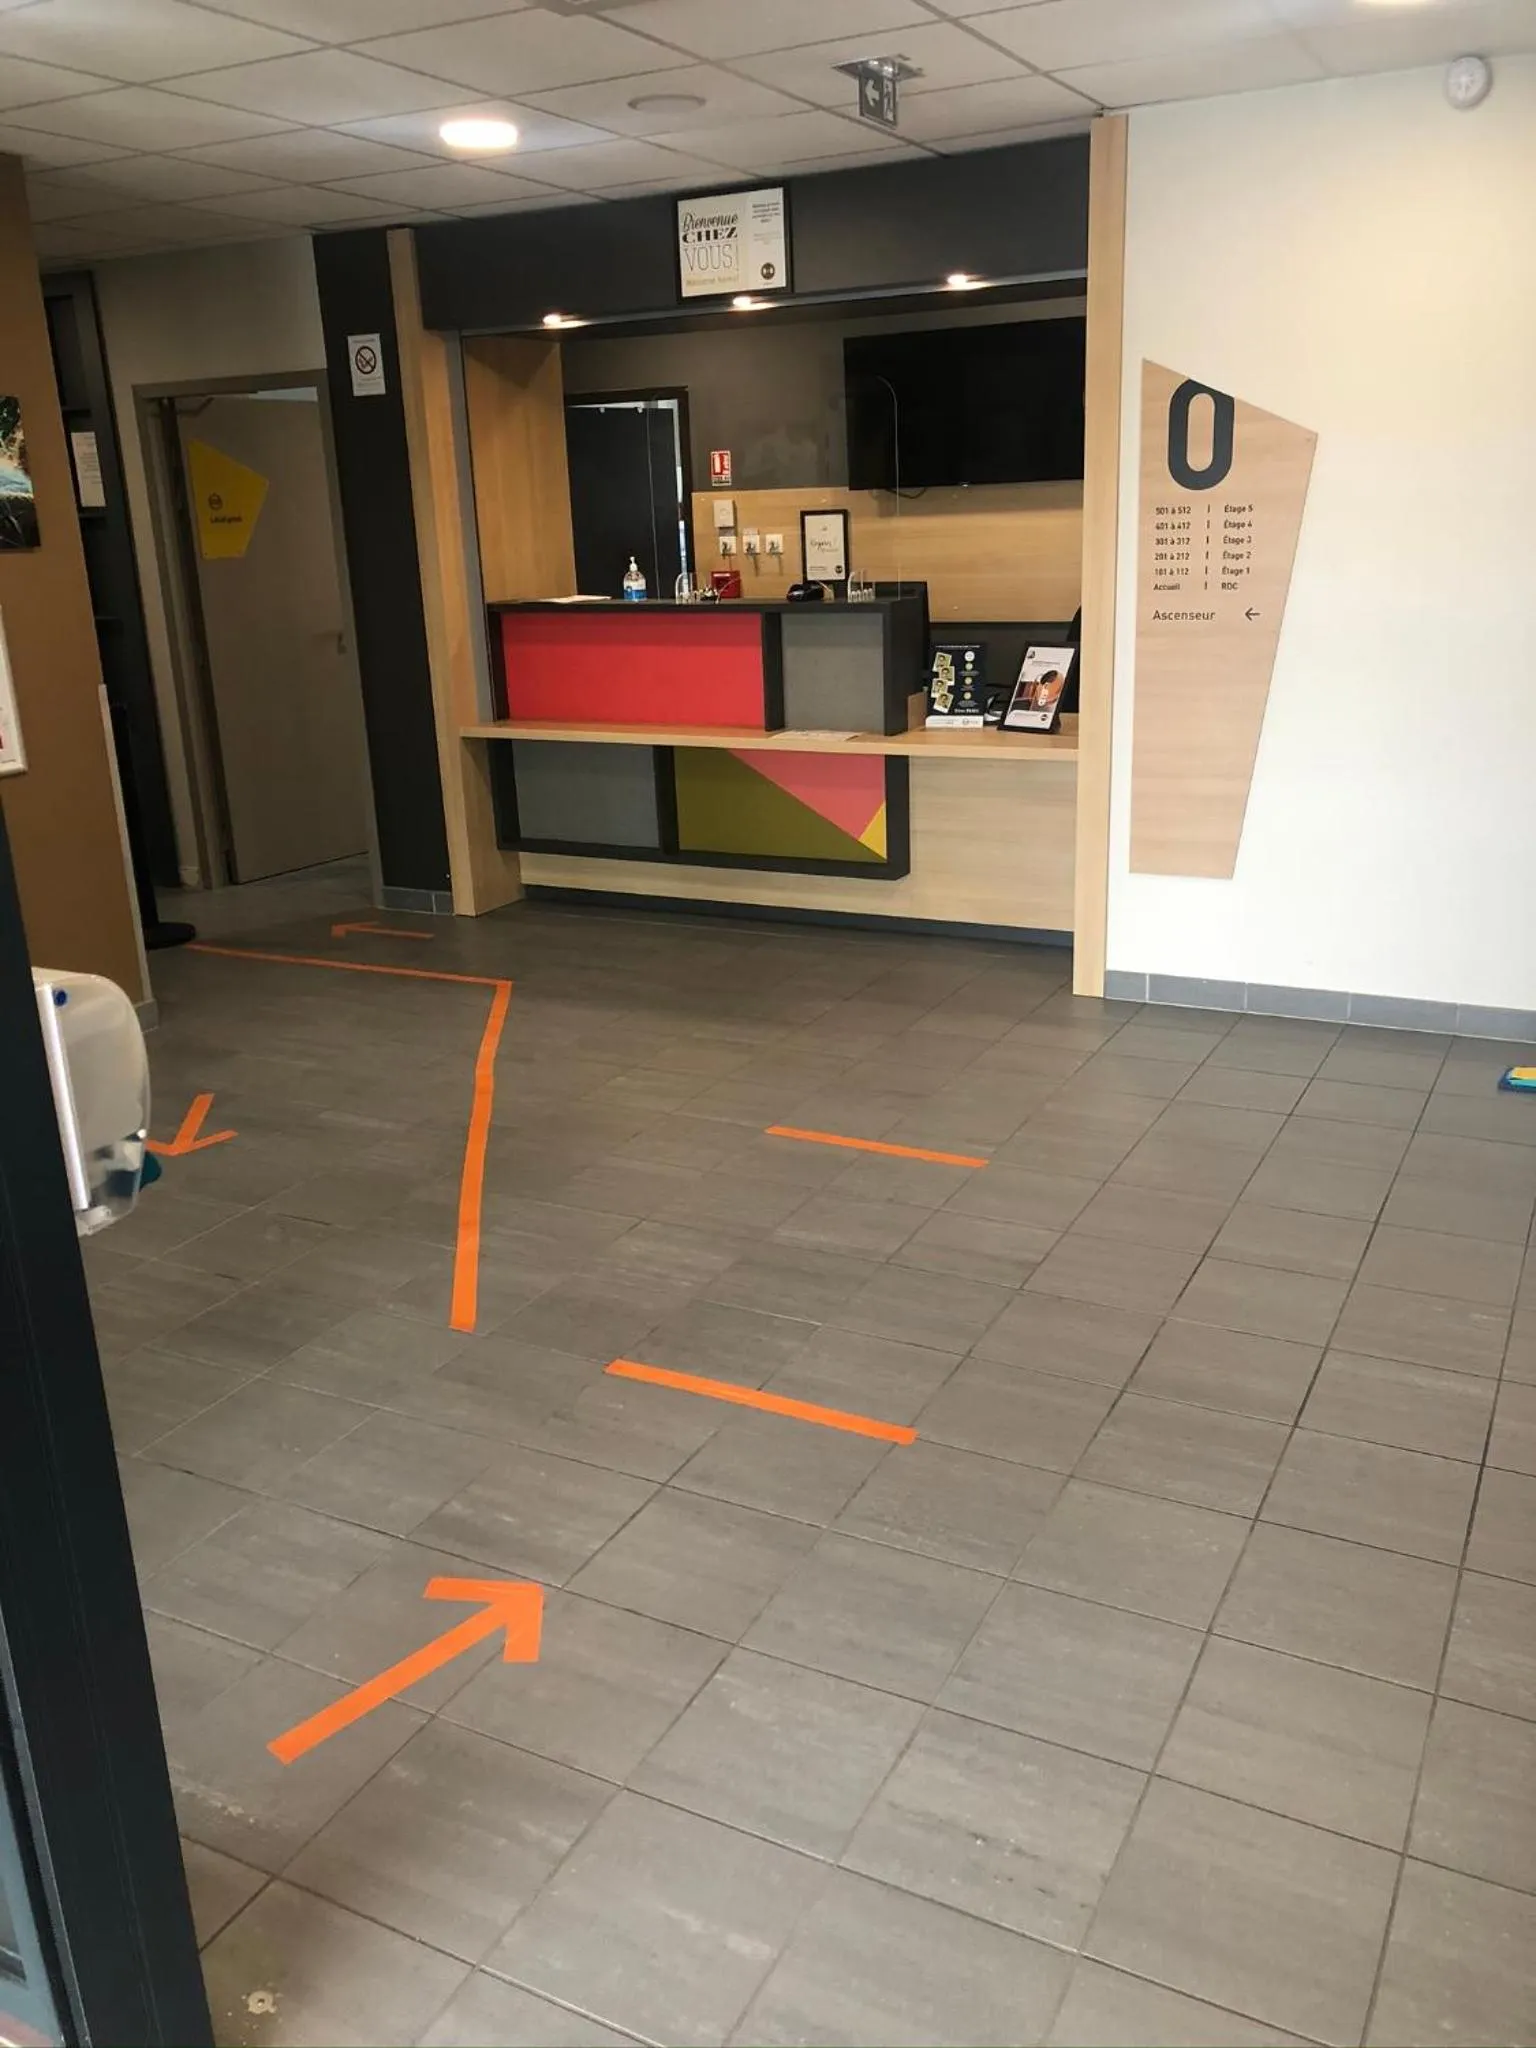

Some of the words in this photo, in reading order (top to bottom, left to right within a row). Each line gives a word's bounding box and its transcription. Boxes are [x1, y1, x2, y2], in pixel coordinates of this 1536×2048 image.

[683, 212, 739, 232] Bienvenue
[682, 226, 738, 244] CHEZ
[1168, 378, 1235, 491] 0
[1224, 504, 1246, 514] Étage
[1223, 519, 1246, 530] Étage
[1223, 535, 1245, 545] Étage
[1222, 550, 1244, 560] Étage
[1222, 565, 1244, 576] Étage
[1153, 583, 1181, 591] Accueil
[1221, 582, 1238, 590] RDC
[1152, 609, 1216, 621] Ascenseur
